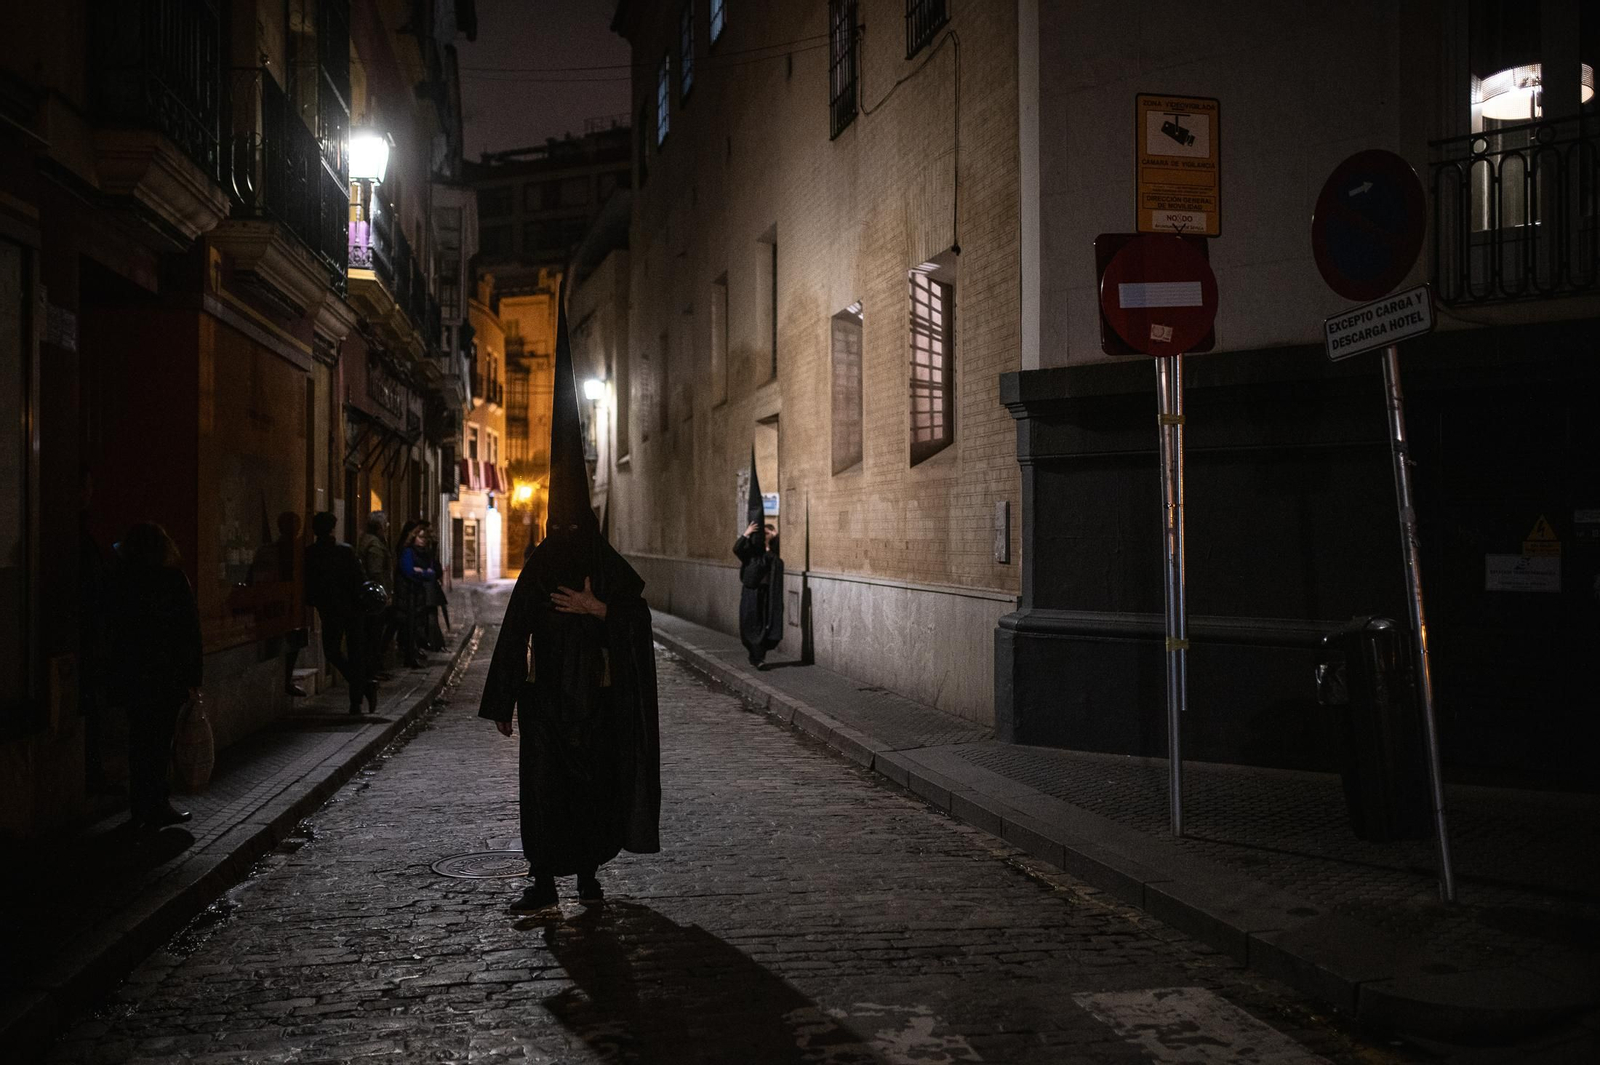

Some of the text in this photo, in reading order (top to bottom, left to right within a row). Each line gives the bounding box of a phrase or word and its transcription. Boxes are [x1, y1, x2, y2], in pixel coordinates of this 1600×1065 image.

[1182, 161, 1216, 169] VIGILANCIA
[1184, 197, 1213, 205] GENERAL
[1328, 292, 1422, 334] EXCEPTO CARGA Y
[1332, 311, 1424, 350] DESCARGA HOTEL
